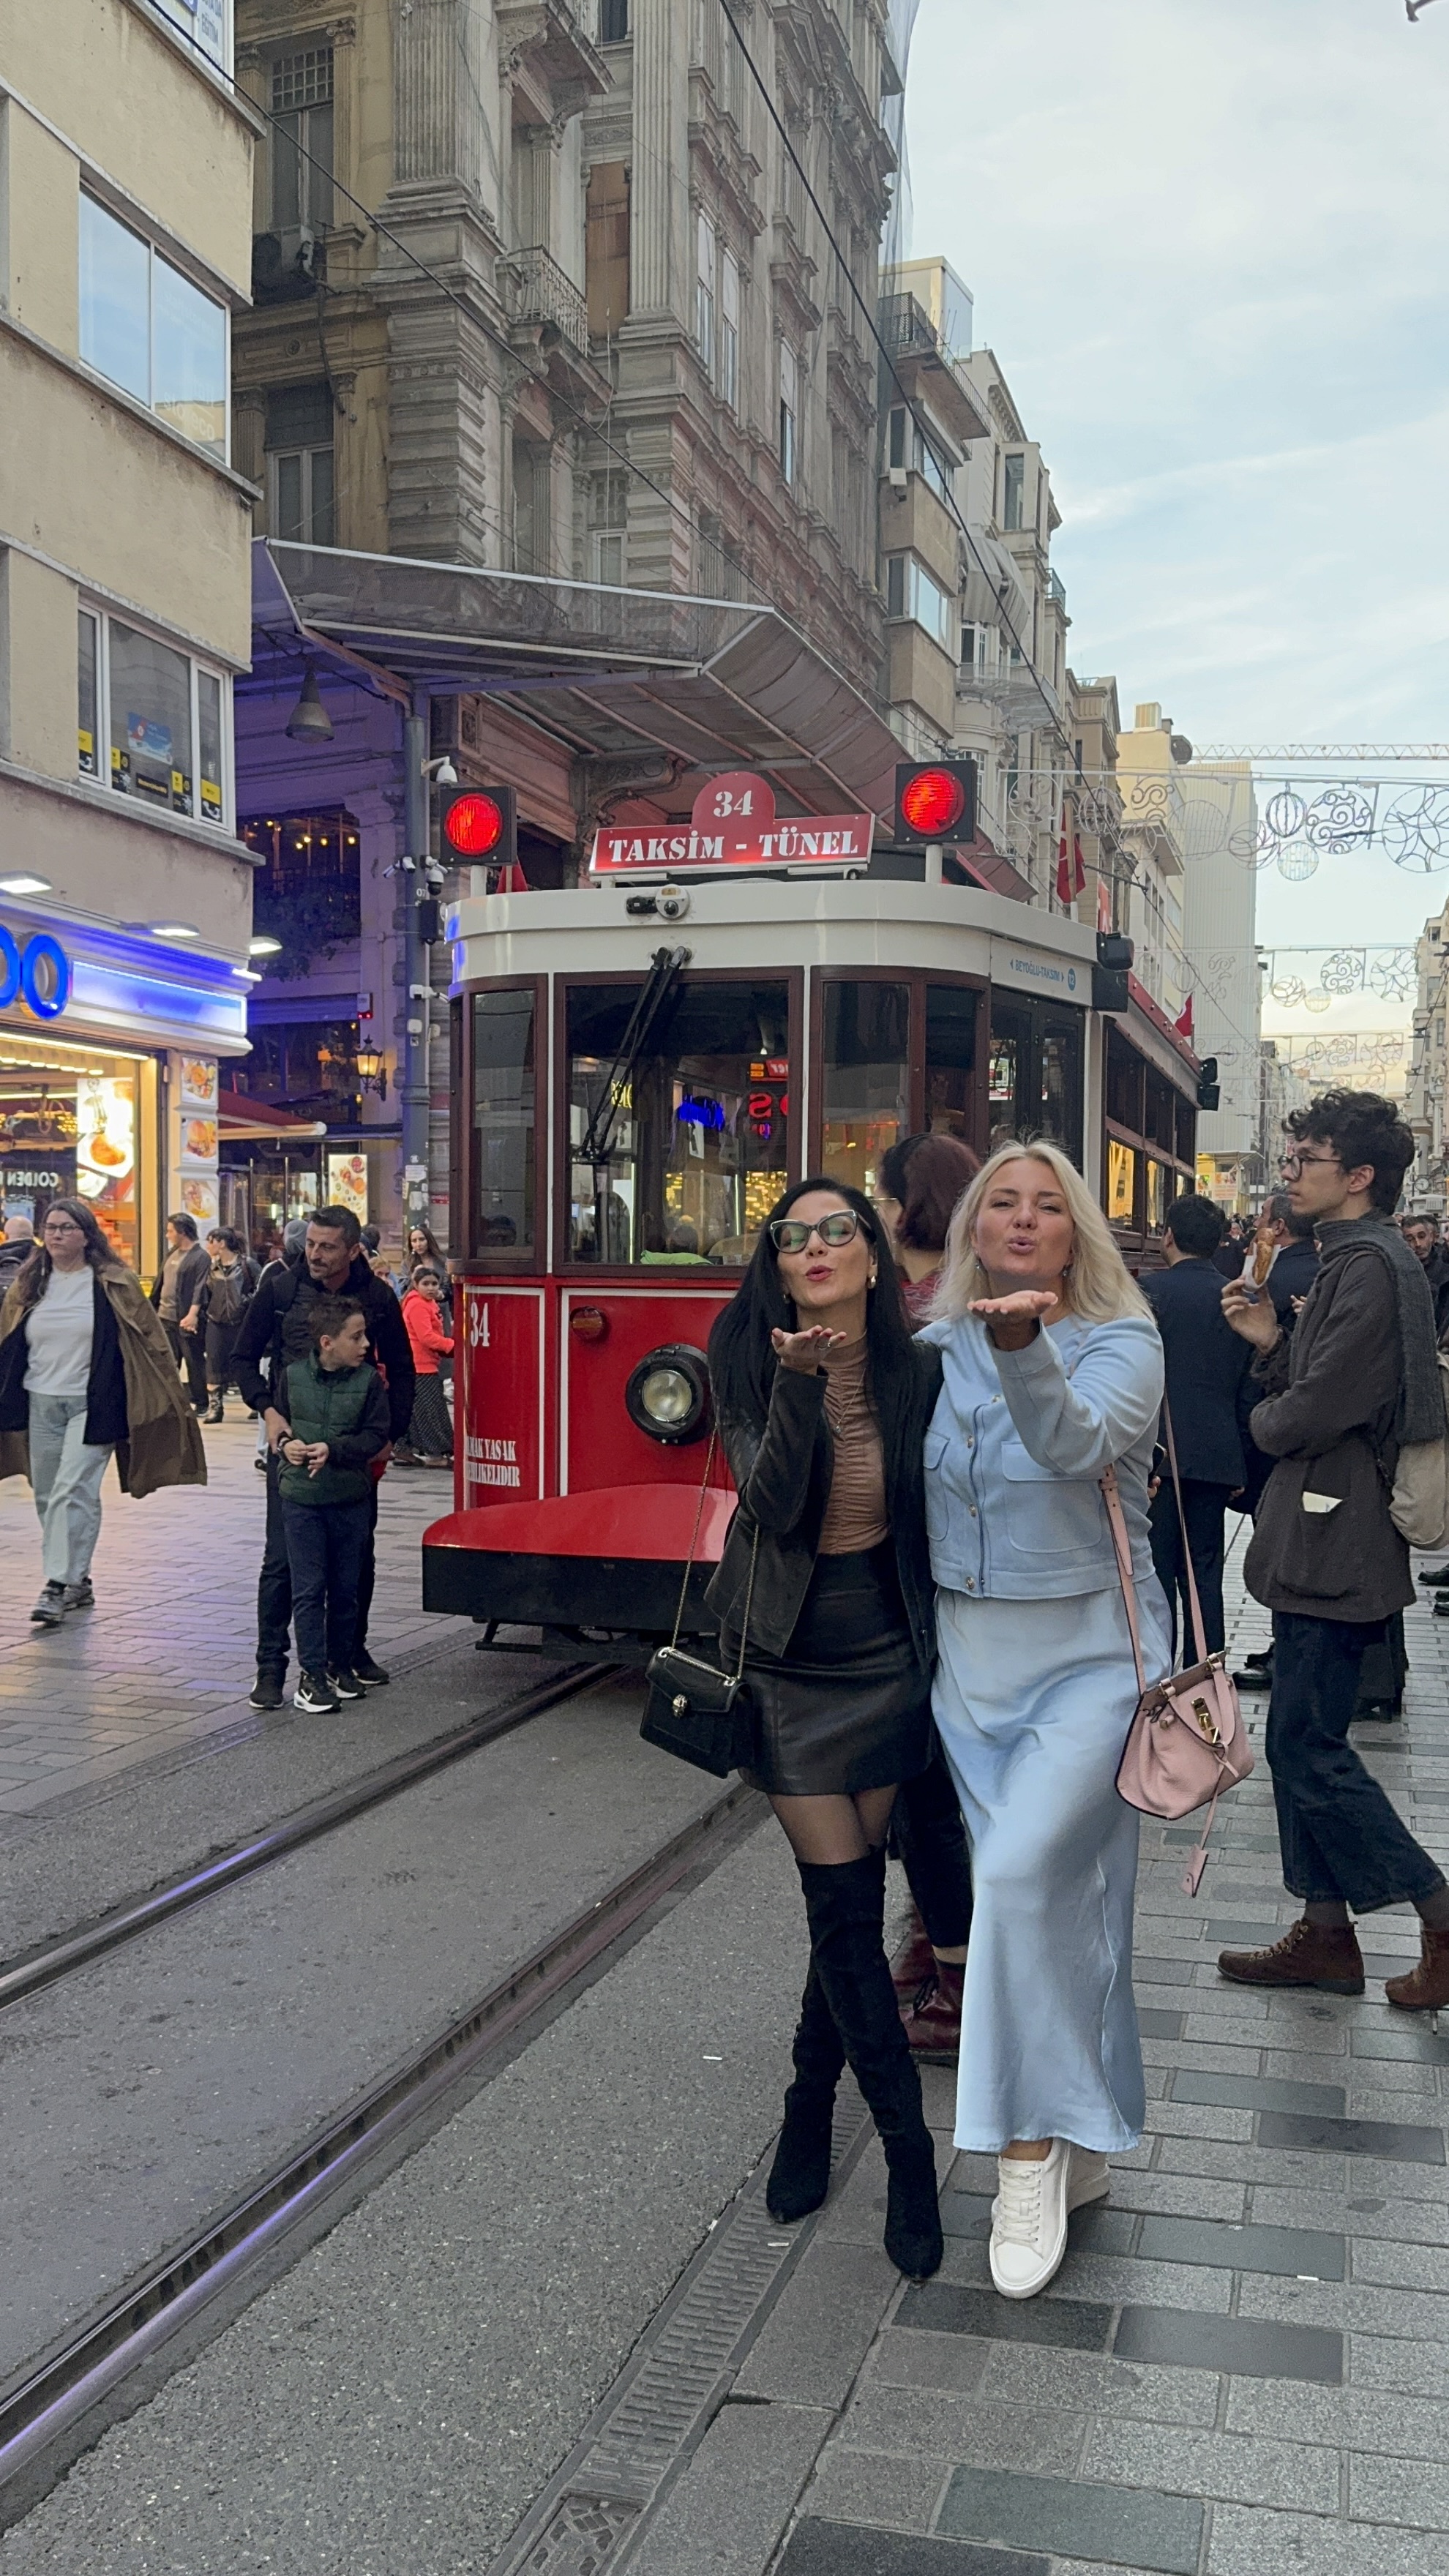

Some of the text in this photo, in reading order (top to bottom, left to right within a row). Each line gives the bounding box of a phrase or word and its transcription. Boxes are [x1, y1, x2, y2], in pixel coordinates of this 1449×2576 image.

[713, 790, 754, 817] 34
[608, 829, 724, 862] TAKSİM
[758, 825, 858, 857] TÜNEL
[470, 1301, 490, 1347] 34
[484, 1439, 517, 1461] YASAK
